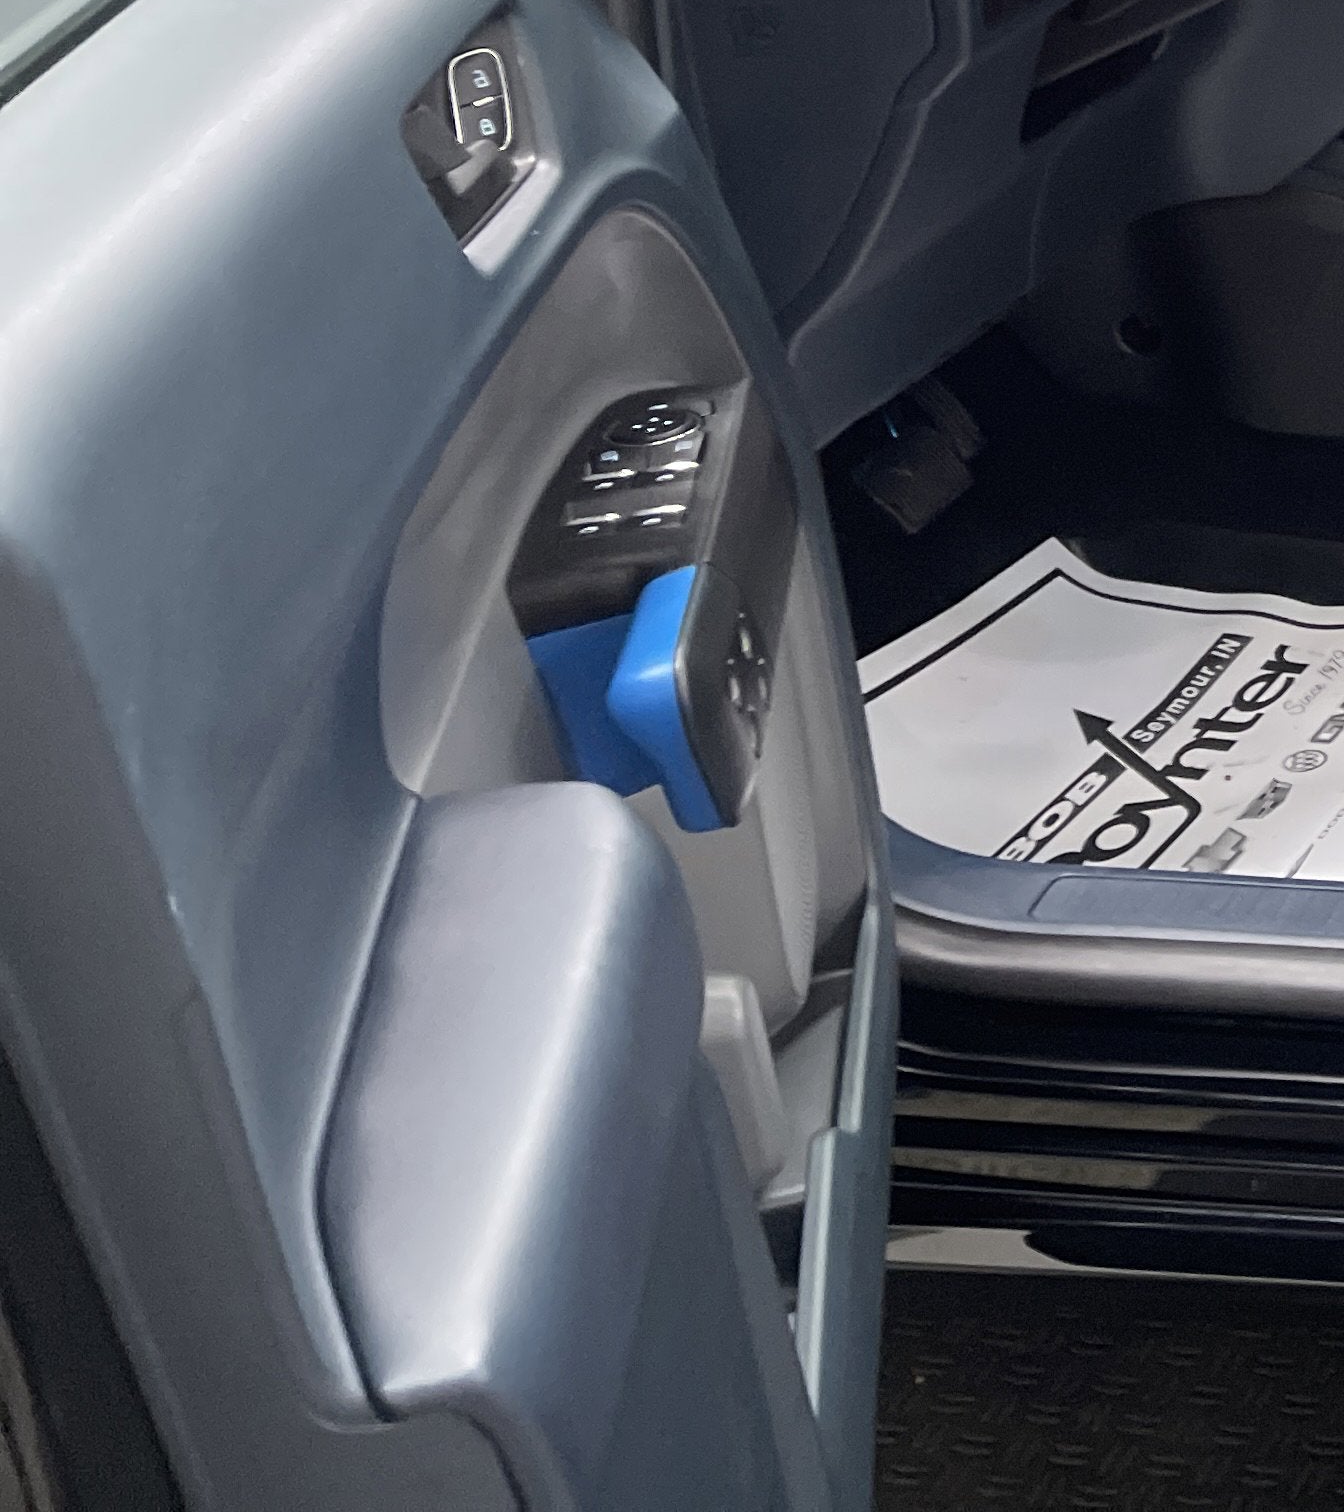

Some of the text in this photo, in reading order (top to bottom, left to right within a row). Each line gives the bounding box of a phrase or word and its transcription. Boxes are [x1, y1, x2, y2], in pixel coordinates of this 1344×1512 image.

[1210, 637, 1242, 660] IN
[1046, 644, 1311, 869] oynter
[999, 771, 1108, 862] BOB
